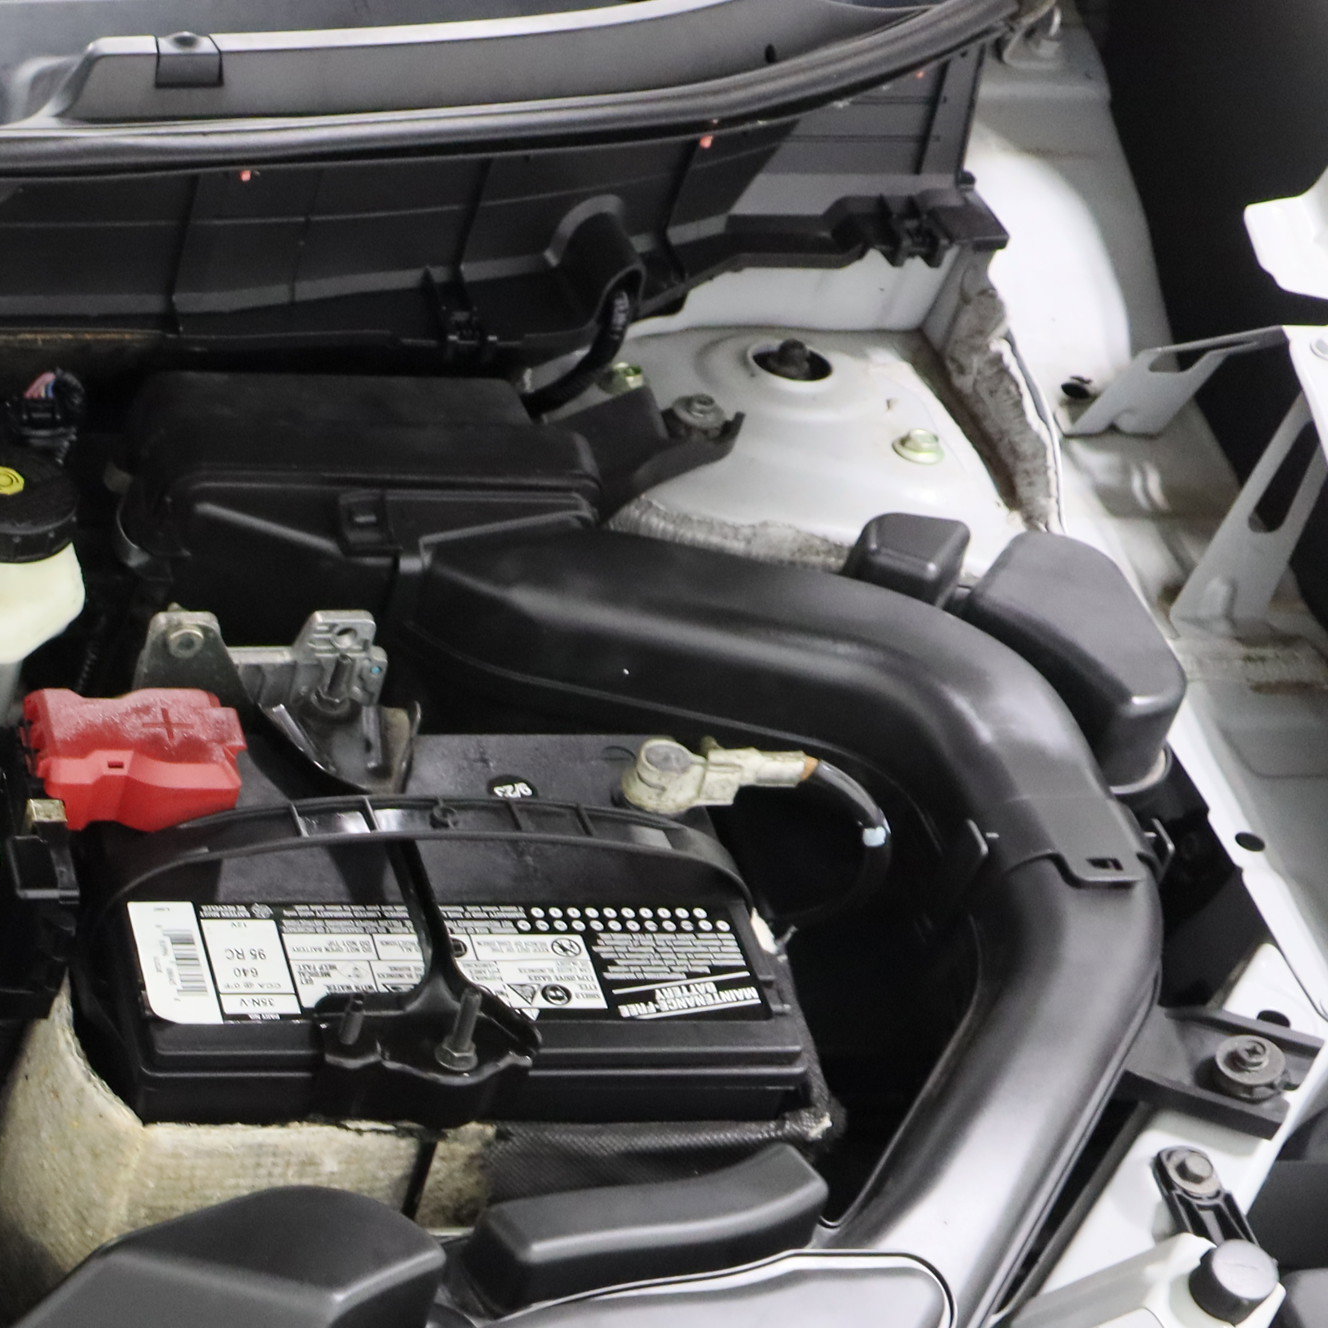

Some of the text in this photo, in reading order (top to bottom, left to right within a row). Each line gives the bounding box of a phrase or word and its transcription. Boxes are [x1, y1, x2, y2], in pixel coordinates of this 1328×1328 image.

[224, 948, 267, 961] 95 RC
[232, 966, 259, 978] 640
[655, 981, 718, 1000] BATTERY
[617, 986, 760, 1018] MAINTENANCE-FREE
